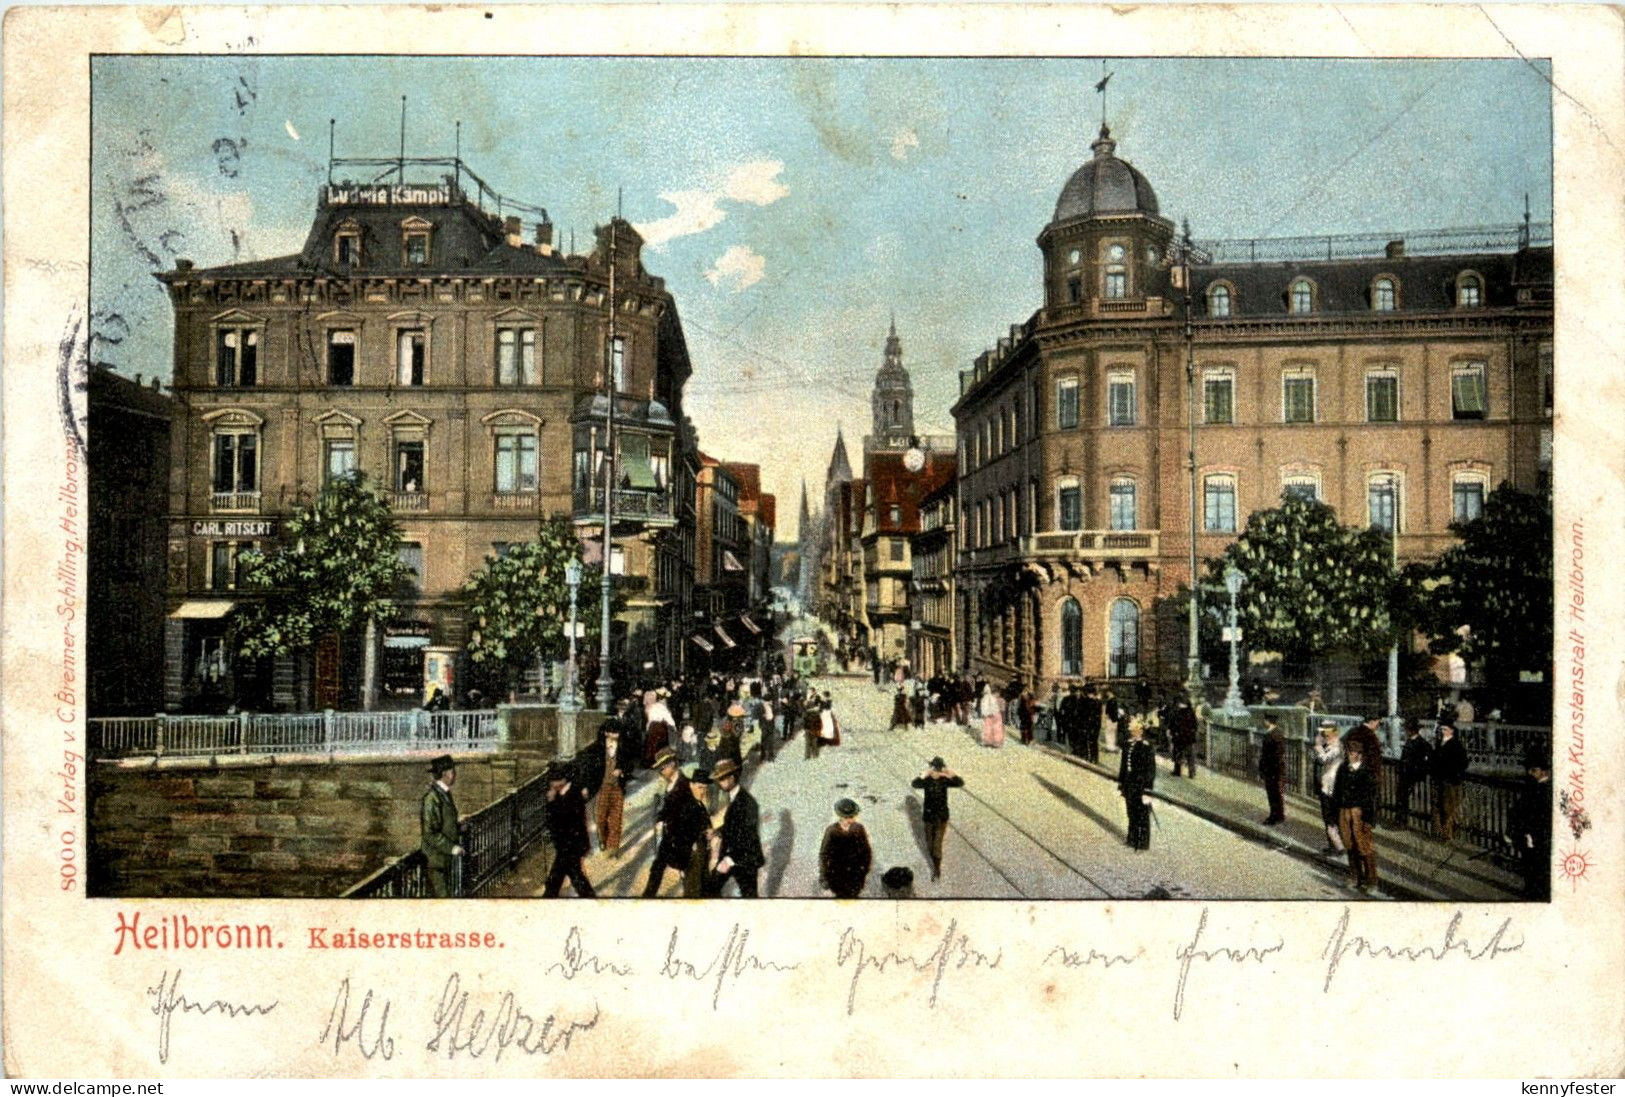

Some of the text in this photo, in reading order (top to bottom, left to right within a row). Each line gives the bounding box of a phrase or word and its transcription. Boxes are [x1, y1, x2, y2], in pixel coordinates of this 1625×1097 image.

[193, 521, 272, 536] CARL RITSERT
[1568, 517, 1585, 622] Heilbronn.
[1568, 630, 1585, 767] Kunstanstalt
[64, 730, 76, 743] v.
[57, 750, 84, 815] Verlag
[114, 912, 505, 955] Heilbronn. Kaiserstrasse.
